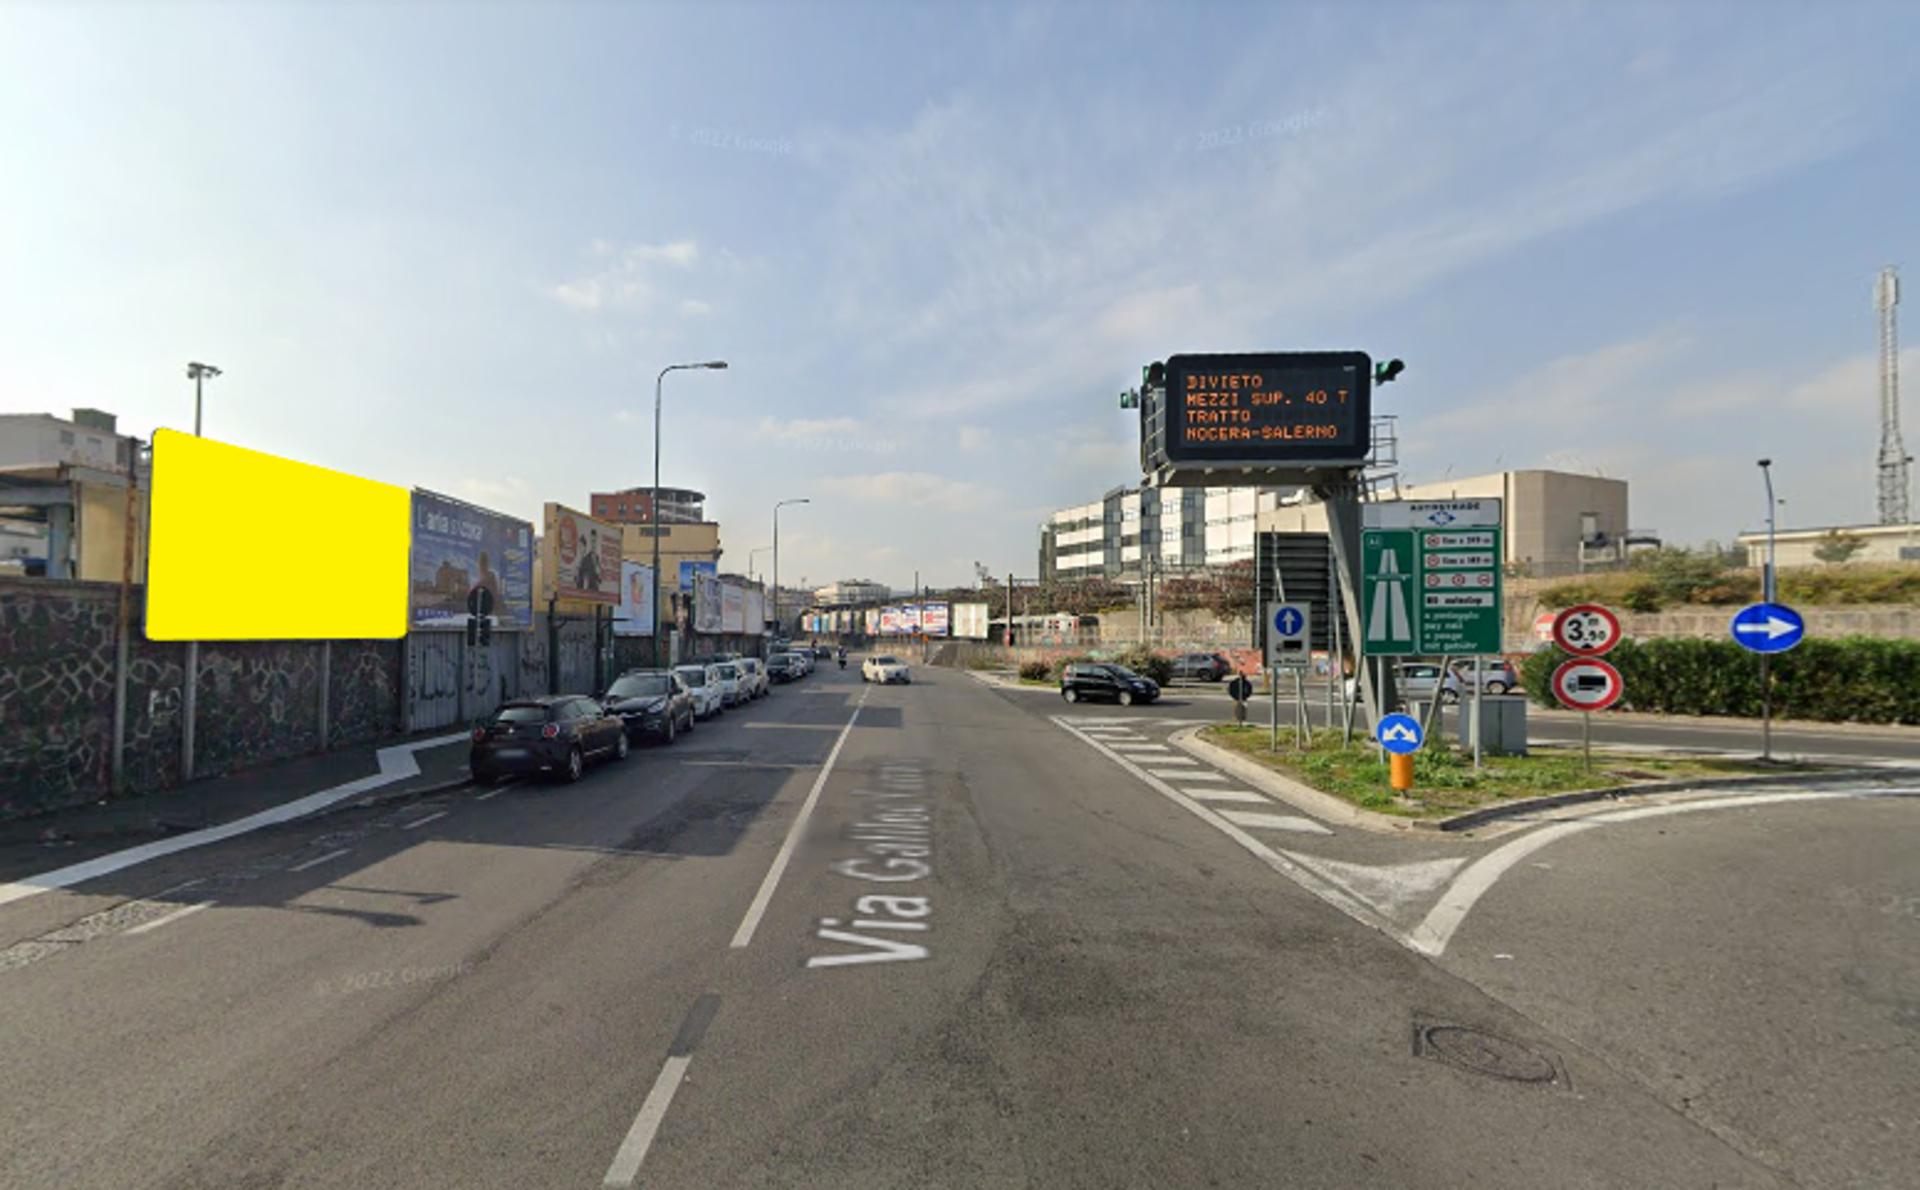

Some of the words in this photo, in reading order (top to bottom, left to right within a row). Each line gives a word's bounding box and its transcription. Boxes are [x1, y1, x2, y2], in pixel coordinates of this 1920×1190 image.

[1186, 375, 1263, 389] DIVIETO
[1186, 392, 1238, 406] MEZZI
[1252, 391, 1292, 405] SUP.
[1306, 390, 1327, 404] 40
[1338, 390, 1348, 404] T
[1187, 409, 1251, 423] TRATTO
[1186, 425, 1337, 441] NOCERA-SALERNO
[1410, 502, 1480, 512] AUTOSTRADE
